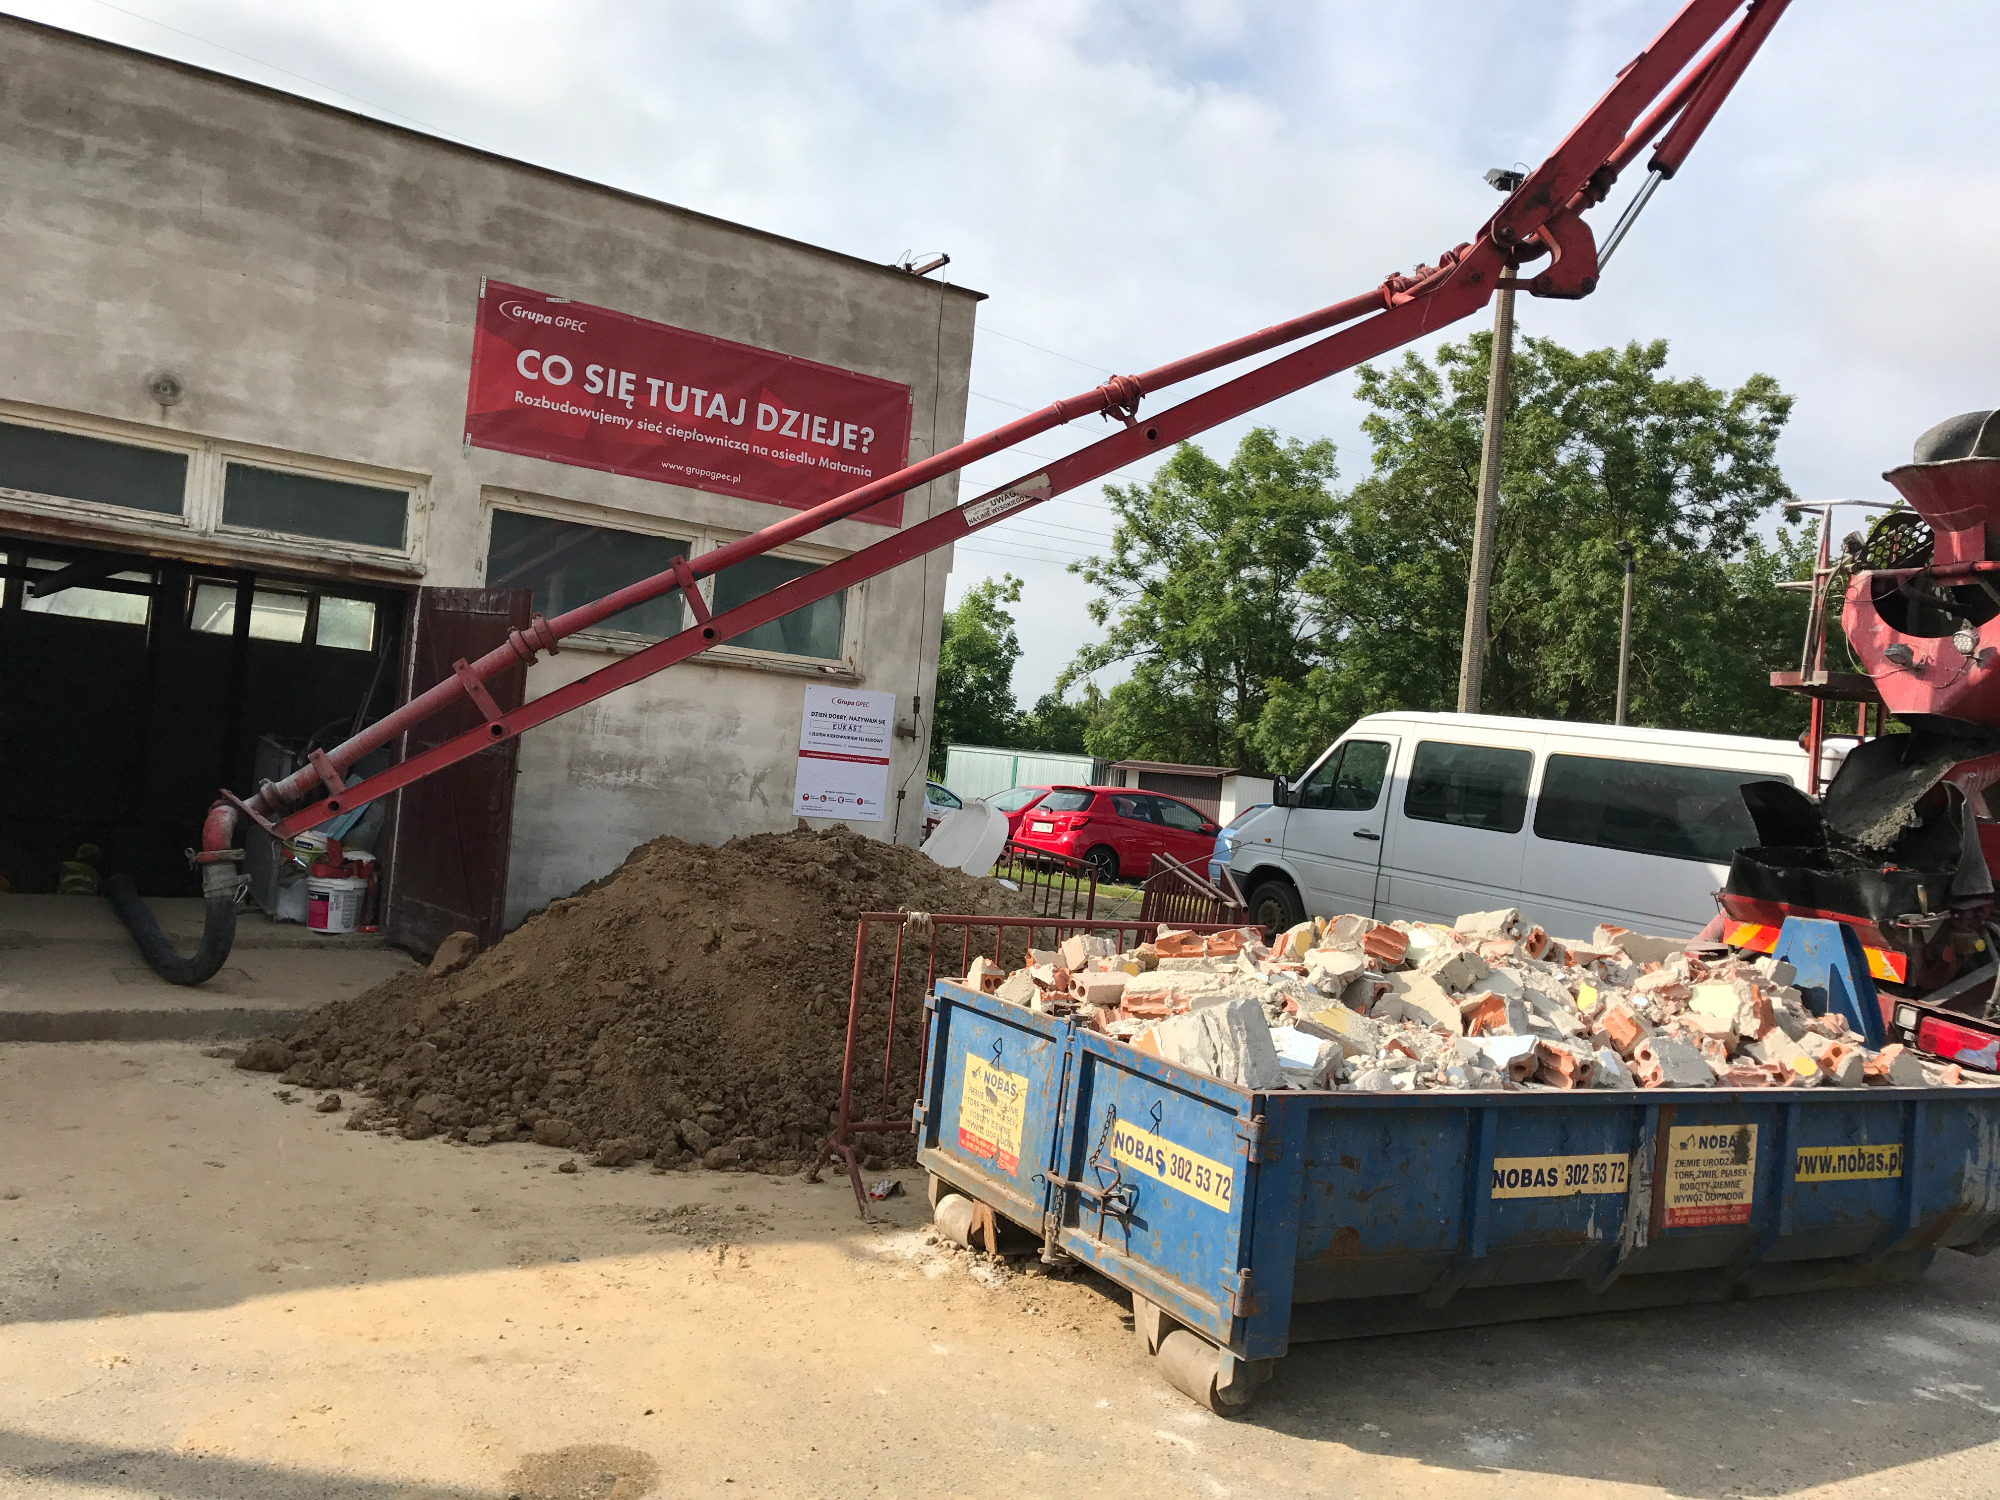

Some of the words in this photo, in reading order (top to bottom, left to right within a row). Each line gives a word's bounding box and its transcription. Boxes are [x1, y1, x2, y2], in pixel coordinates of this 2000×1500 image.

[512, 305, 552, 324] Grupa
[554, 316, 588, 333] GPEC
[516, 349, 573, 386] CO
[583, 364, 637, 410] SIĘ
[646, 376, 747, 426] TUTAJ
[756, 402, 875, 454] DZIEJE?
[514, 390, 634, 430] Rozbudowujemy
[636, 417, 663, 434] sieć
[665, 423, 749, 455] ciepłowniczą
[752, 444, 769, 456] na
[771, 447, 816, 466] osiedlu
[818, 456, 873, 478] Matarnia
[661, 461, 741, 485] www.grupagpec.pl
[989, 491, 1020, 507] UWAG
[836, 698, 855, 707] Grupa
[855, 700, 870, 708] GPEC
[848, 716, 878, 724] NAZYWAM
[983, 1070, 1017, 1097] NOBAS
[1698, 1134, 1738, 1150] NOBA
[1114, 1129, 1165, 1168] NOBAS
[1169, 1153, 1192, 1184] 302
[1195, 1164, 1212, 1193] 53
[1215, 1172, 1232, 1202] 72
[1674, 1158, 1701, 1168] ZIEMIE
[1720, 1168, 1748, 1178] PIASEK
[1492, 1167, 1558, 1189] NOBAS
[1565, 1163, 1589, 1187] 302
[1592, 1162, 1607, 1185] 53
[1610, 1161, 1625, 1183] 72
[1679, 1181, 1710, 1192] ROBOTY
[1712, 1179, 1742, 1190] ZIEMNE
